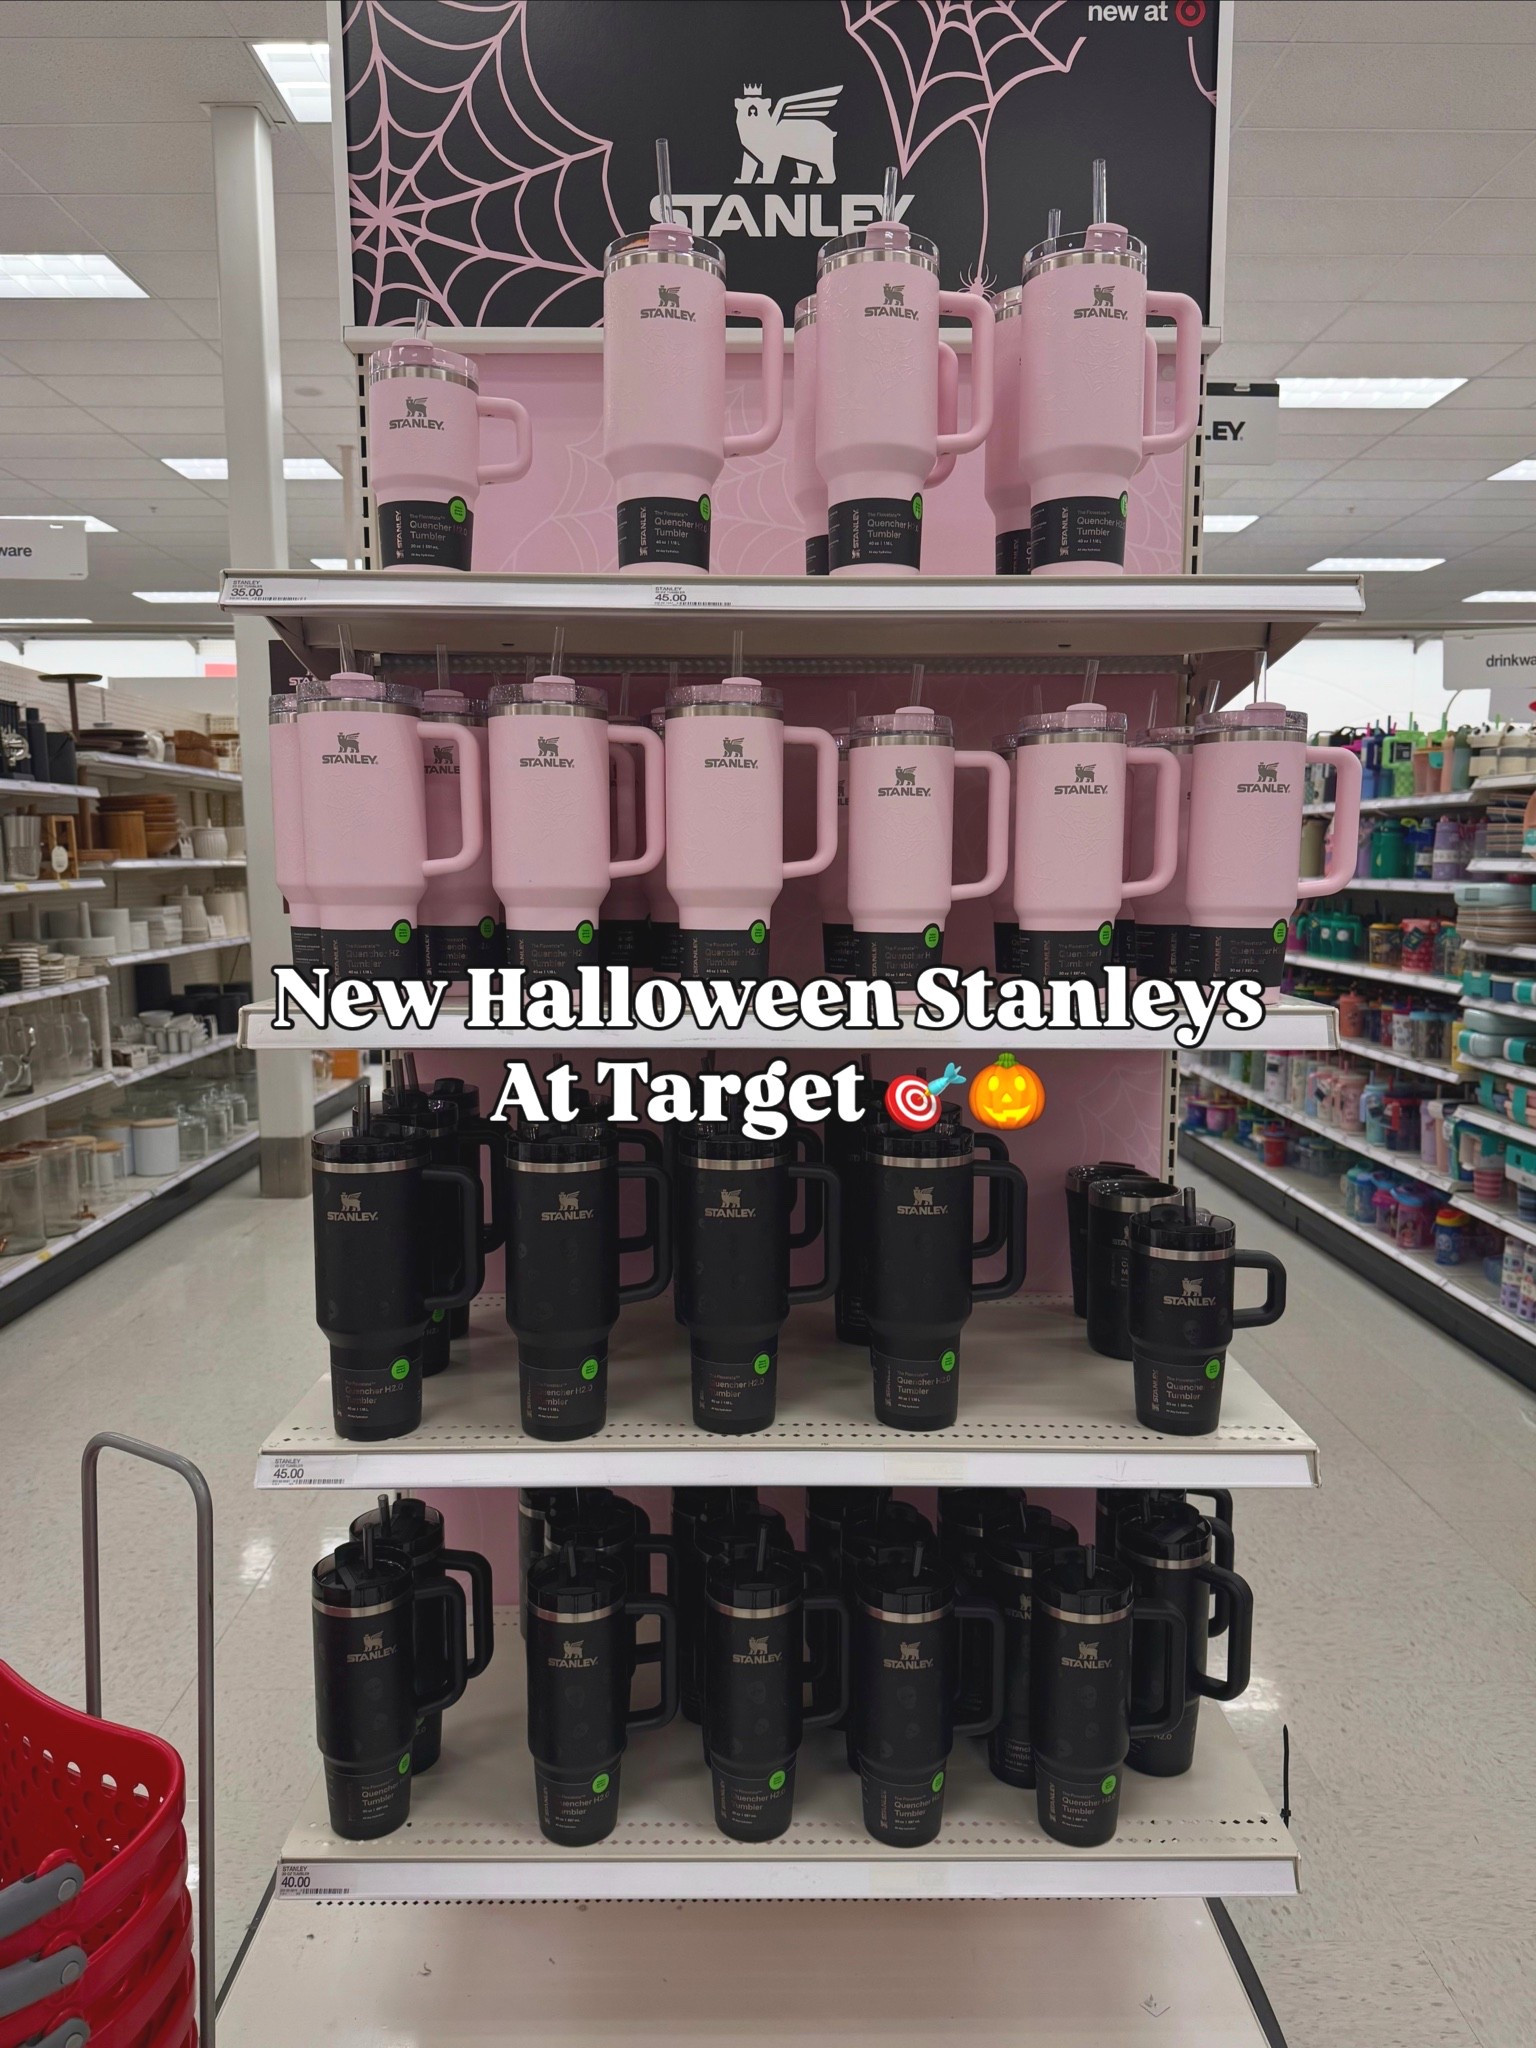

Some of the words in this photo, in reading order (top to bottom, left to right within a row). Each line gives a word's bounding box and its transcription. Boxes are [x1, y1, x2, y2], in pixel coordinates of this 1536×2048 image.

[1088, 4, 1139, 21] new
[1144, 1, 1168, 21] at
[650, 194, 915, 237] STANLEY
[640, 308, 696, 322] STANLEY
[864, 306, 919, 320] STANLEY
[1073, 306, 1128, 320] STANLEY
[389, 419, 445, 430] STANLEY
[409, 520, 452, 532] Quencher
[654, 517, 694, 529] Quencher
[867, 519, 906, 530] Quencher
[1076, 516, 1115, 527] Quencher
[409, 531, 446, 541] Tumbler
[654, 528, 689, 538] Tumbler
[867, 529, 901, 539] Tumbler
[1077, 527, 1110, 537] Tumbler
[231, 588, 264, 597] 35.00
[655, 594, 687, 602] 45.00
[322, 754, 378, 765] STANLEY
[520, 758, 574, 768] STANLEY
[704, 758, 759, 769] STANLEY
[424, 765, 460, 775] TANLE
[878, 787, 931, 797] STANLEY
[1054, 784, 1108, 795] STANLEY
[1237, 783, 1291, 794] STANLEY
[541, 1209, 593, 1221] STANLEY
[704, 1208, 756, 1218] STANLEY
[897, 1205, 948, 1215] STANLEY
[327, 1211, 378, 1221] STANLEY
[1163, 1296, 1215, 1307] STANLEY
[715, 1381, 747, 1389] uencher
[897, 1376, 934, 1386] Quencher
[1166, 1381, 1204, 1391] Quenche
[384, 1383, 404, 1393] H2.0
[897, 1385, 929, 1395] Tumbler
[1166, 1390, 1201, 1400] Tumbler
[273, 1468, 304, 1479] 45.00
[346, 1647, 397, 1663] STANLEY
[732, 1654, 782, 1664] STANLEY
[548, 1657, 598, 1668] STANLEY
[883, 1658, 933, 1670] STANLEY
[1061, 1657, 1112, 1669] STANLEY
[362, 1782, 399, 1799] Quencher
[362, 1793, 394, 1806] Tumbler
[894, 1800, 931, 1809] Quencher
[1062, 1796, 1100, 1807] Quencher
[894, 1809, 926, 1817] Tumbler
[1062, 1804, 1095, 1815] Tumbler
[281, 1876, 311, 1888] 40.00
